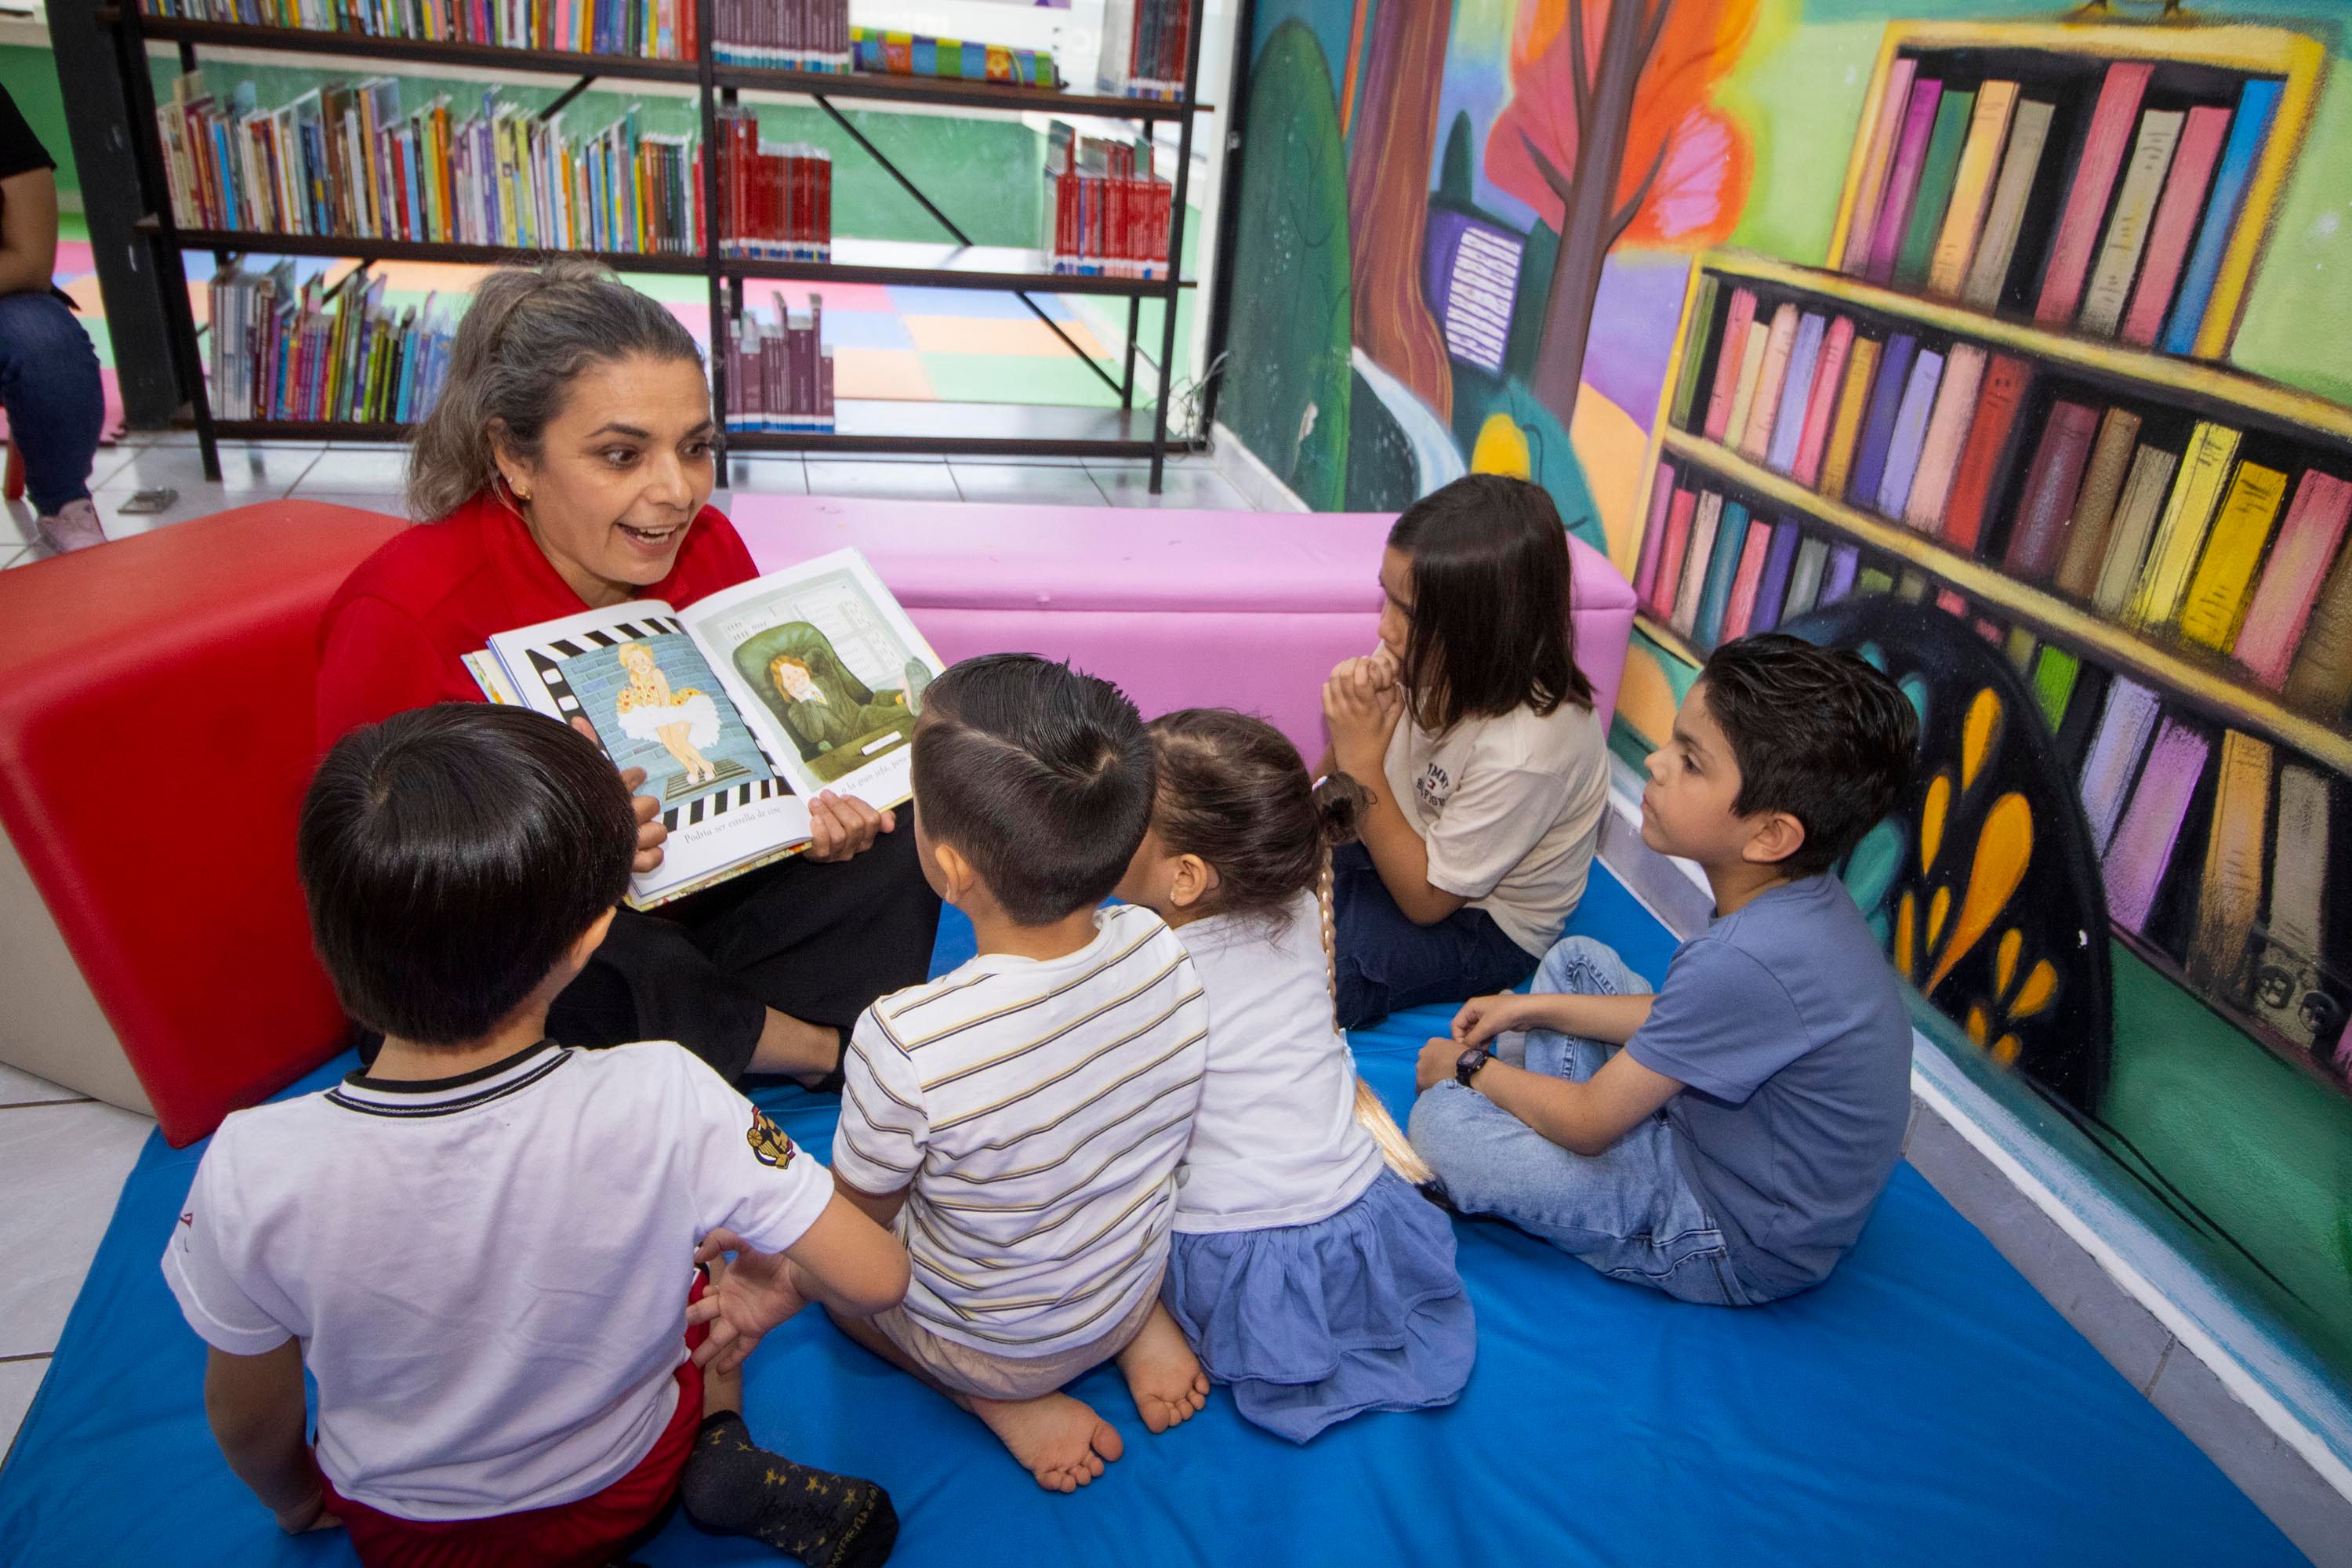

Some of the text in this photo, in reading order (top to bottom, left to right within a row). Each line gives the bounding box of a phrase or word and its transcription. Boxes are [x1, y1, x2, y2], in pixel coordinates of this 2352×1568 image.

[714, 824, 726, 833] ser
[728, 815, 757, 829] estrella
[757, 808, 767, 817] de
